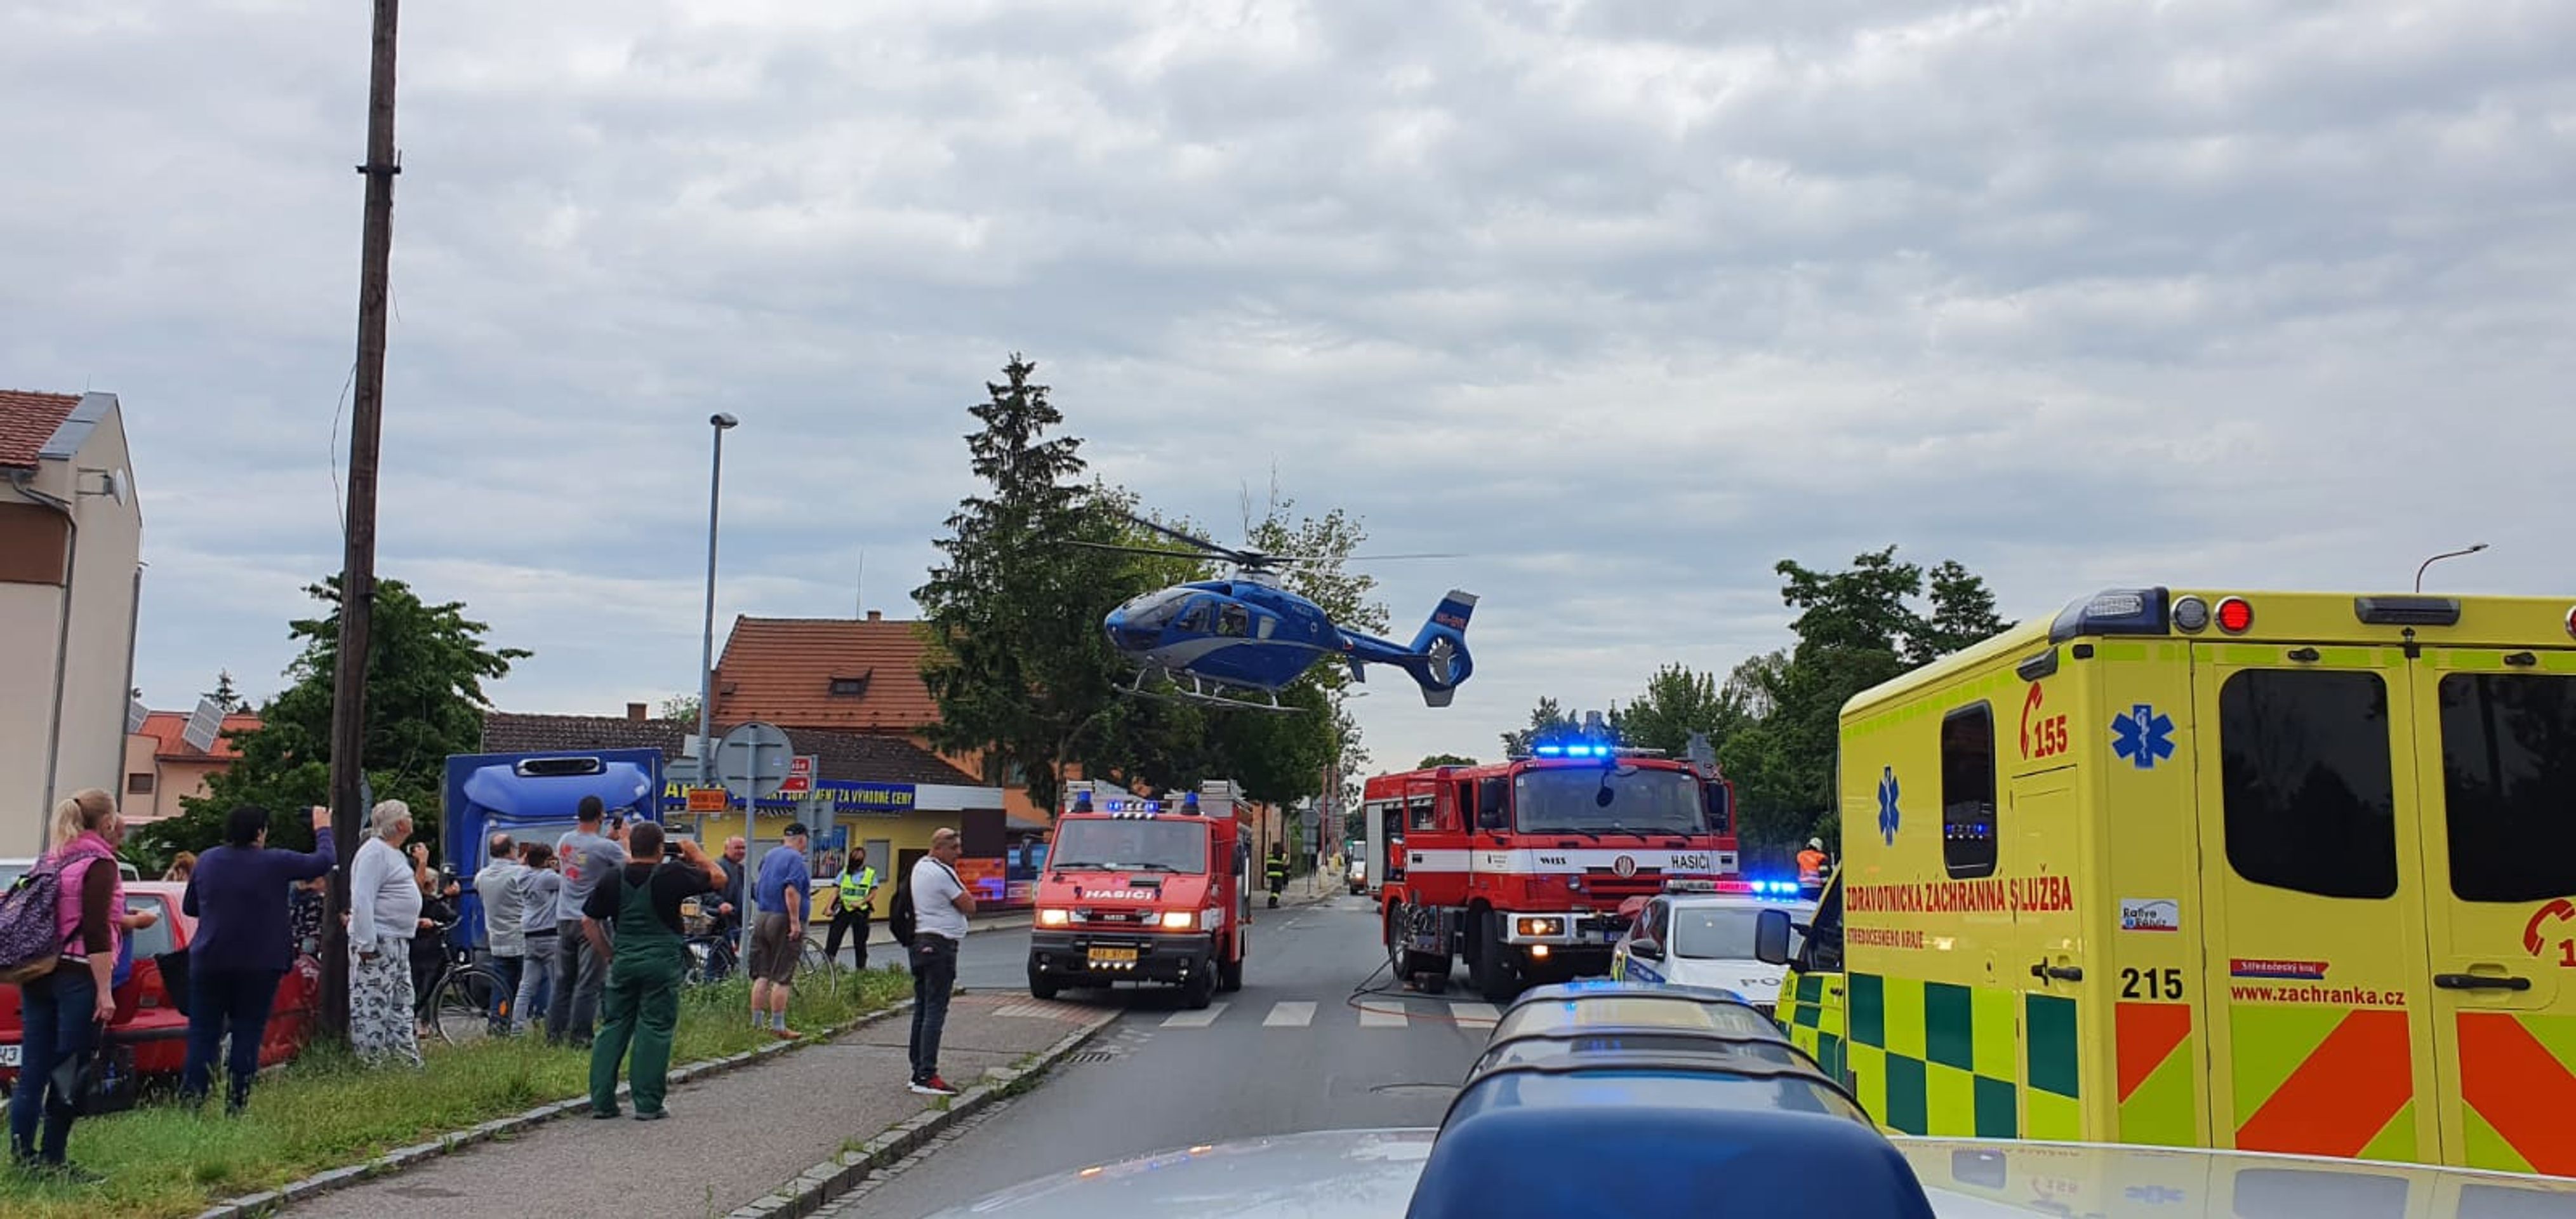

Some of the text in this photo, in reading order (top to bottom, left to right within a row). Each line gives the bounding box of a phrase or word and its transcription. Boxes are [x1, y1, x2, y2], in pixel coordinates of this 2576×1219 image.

[2035, 714, 2067, 758] 155
[839, 789, 849, 803] ZA
[891, 792, 913, 805] CENY
[1671, 852, 1710, 869] HASIČI
[1846, 863, 2074, 912] ZDRAVOTNICKÁ ZÁCHRANNÁ SLUŽBA
[2121, 967, 2183, 1000] 215
[2231, 985, 2405, 1006] www.zachranka.cz
